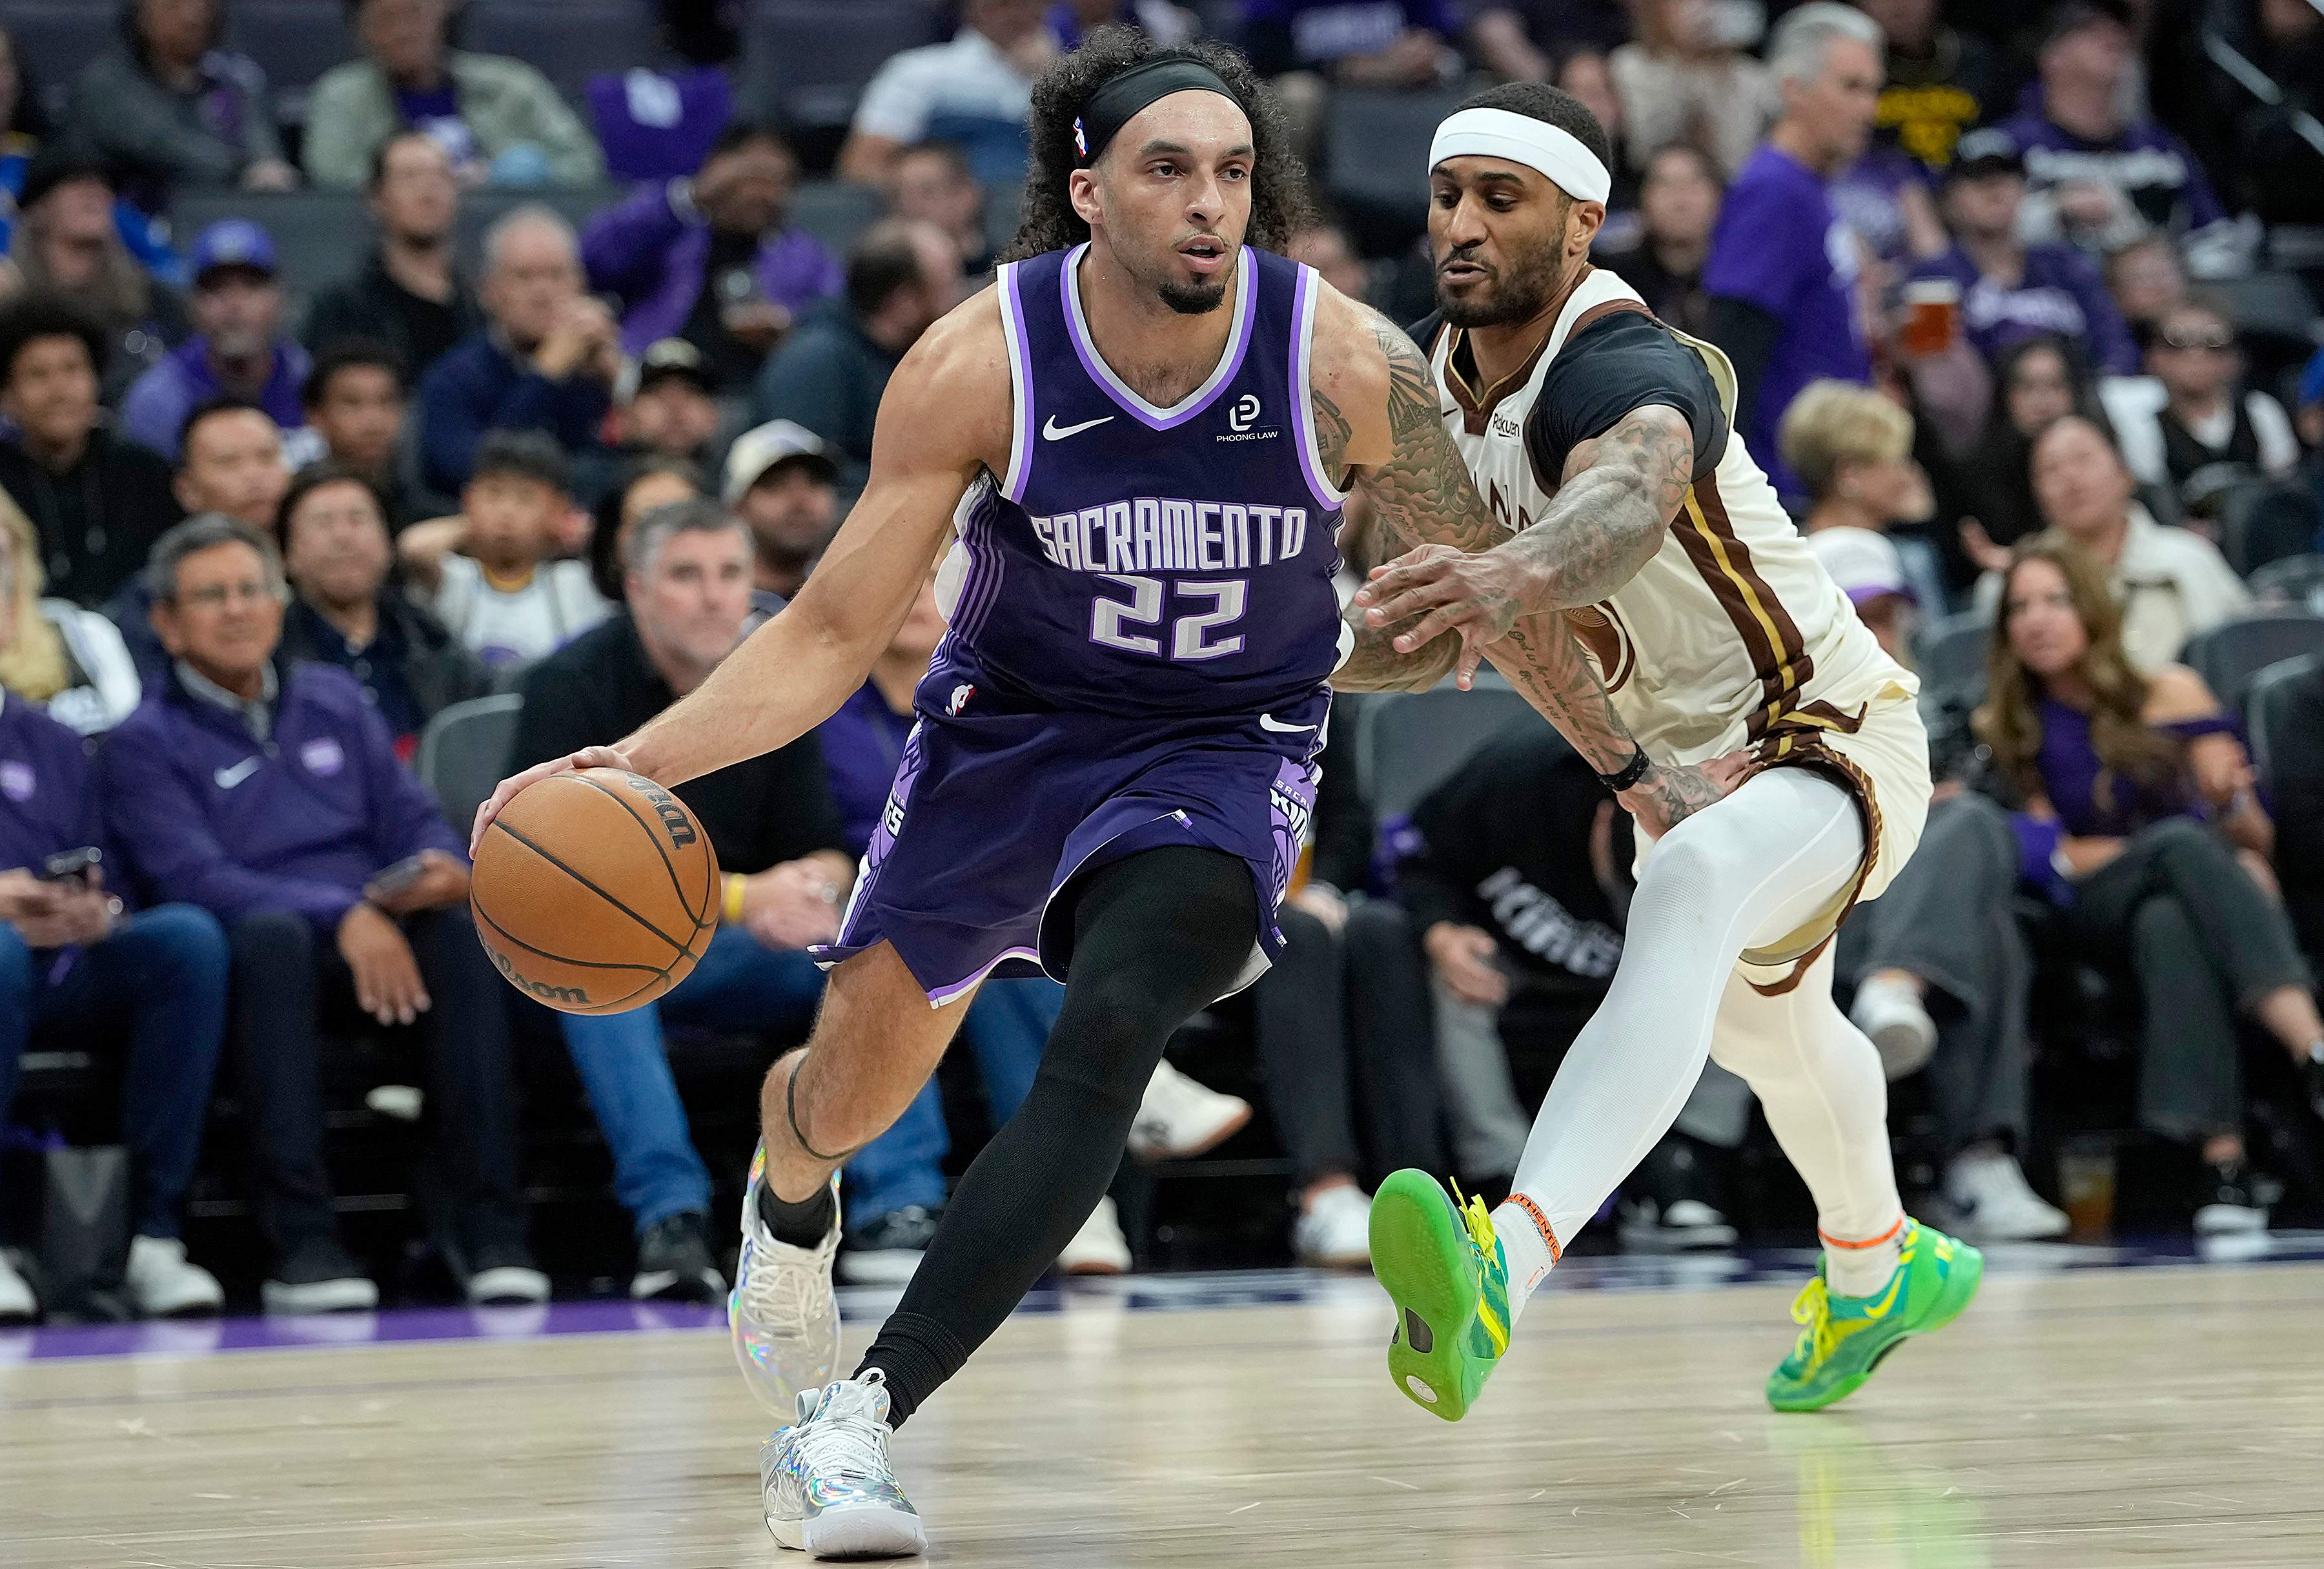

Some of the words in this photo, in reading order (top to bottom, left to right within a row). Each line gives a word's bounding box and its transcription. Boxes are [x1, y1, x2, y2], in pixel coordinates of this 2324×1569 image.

[1216, 433, 1256, 442] PHOONG
[1031, 497, 1308, 571] SACRAMENTO
[1088, 573, 1250, 661] 22
